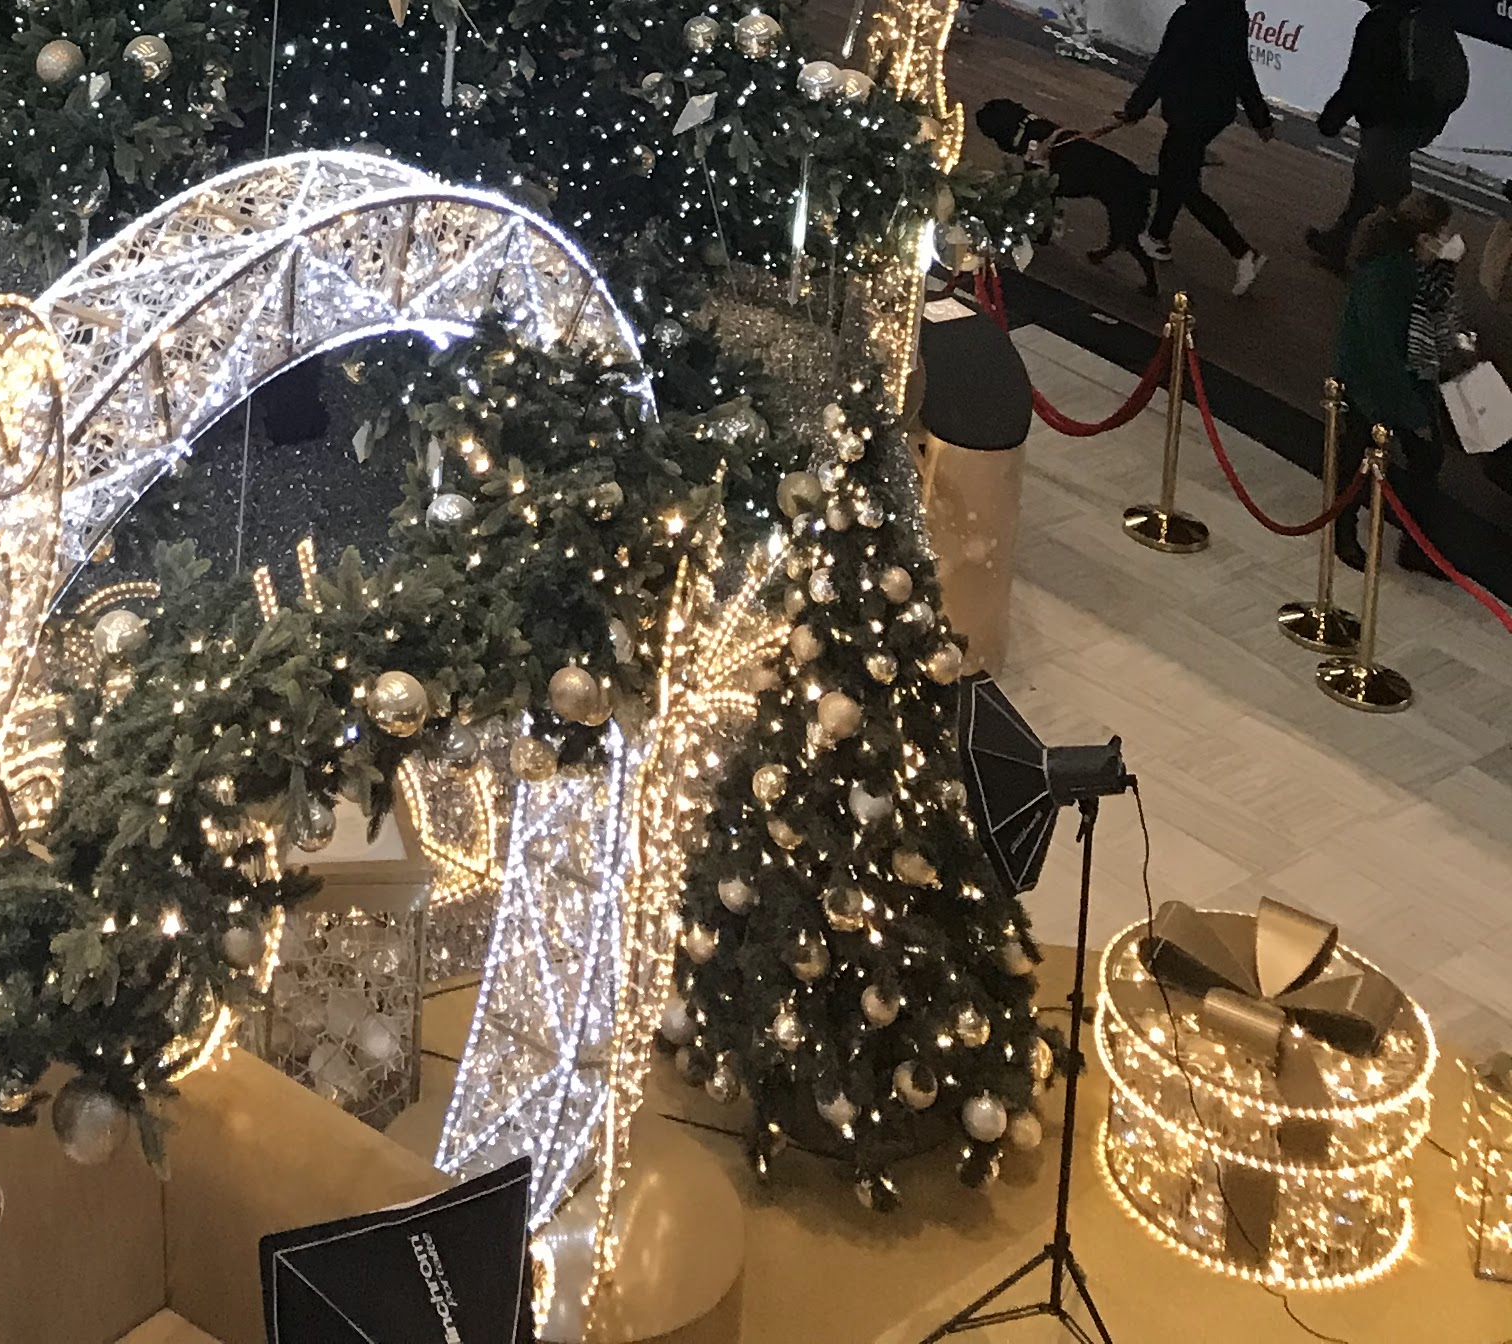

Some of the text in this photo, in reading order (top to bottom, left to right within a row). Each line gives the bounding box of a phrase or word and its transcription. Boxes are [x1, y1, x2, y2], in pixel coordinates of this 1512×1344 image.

[1248, 11, 1304, 52] field
[1248, 44, 1282, 71] EMPS
[410, 1235, 464, 1344] linchrom
